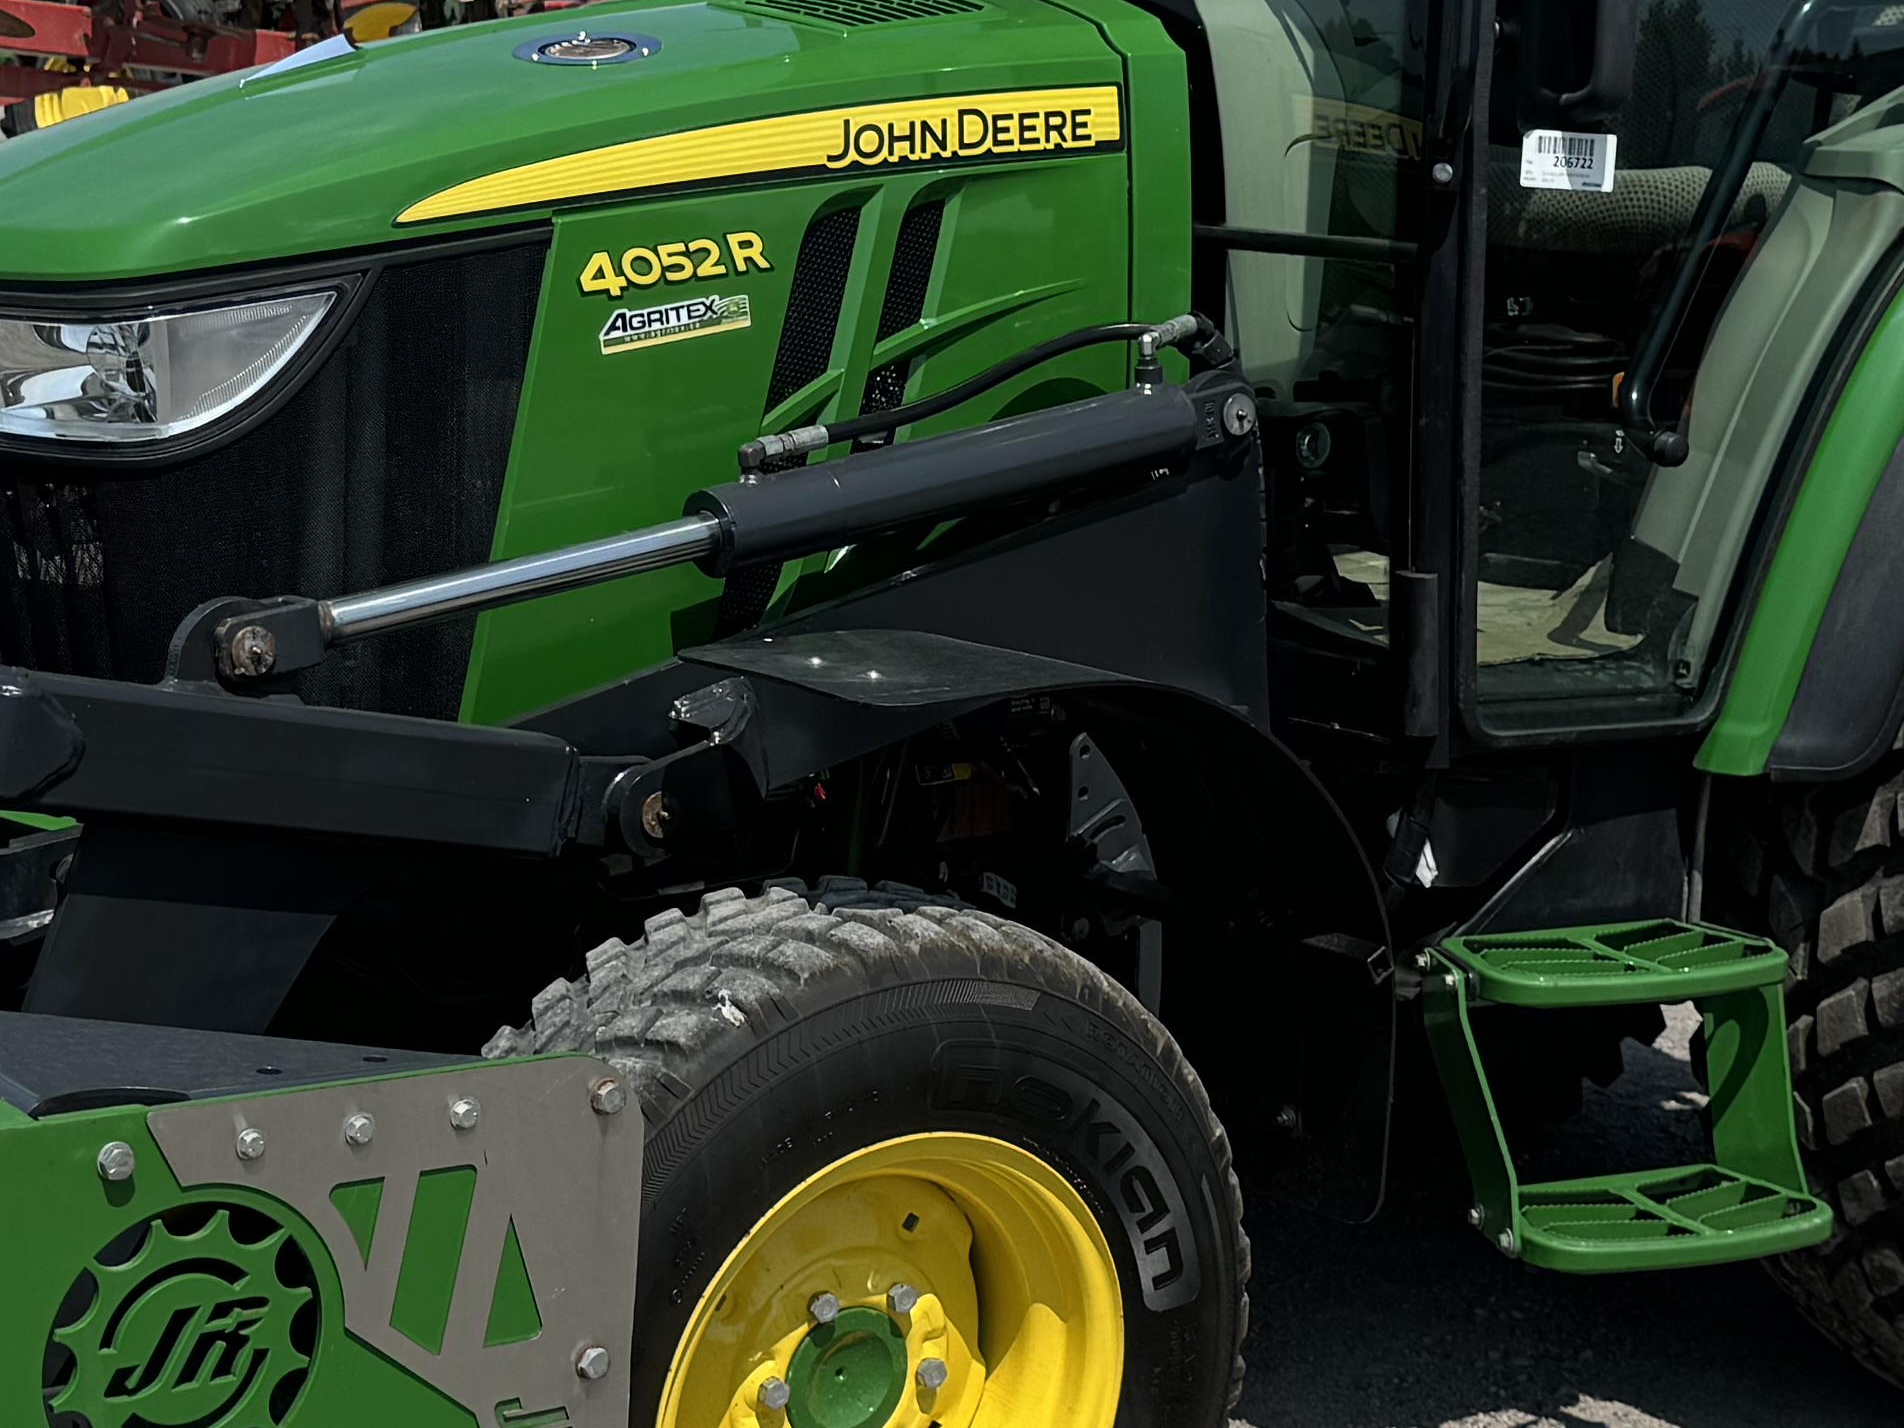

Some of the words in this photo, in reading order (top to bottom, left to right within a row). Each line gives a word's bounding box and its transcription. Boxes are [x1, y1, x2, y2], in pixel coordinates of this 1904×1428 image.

[827, 115, 948, 164] JOHN
[955, 108, 1093, 156] DEERE
[1552, 155, 1595, 170] 206722
[603, 299, 719, 337] AGRITEX
[103, 1294, 271, 1399] JR
